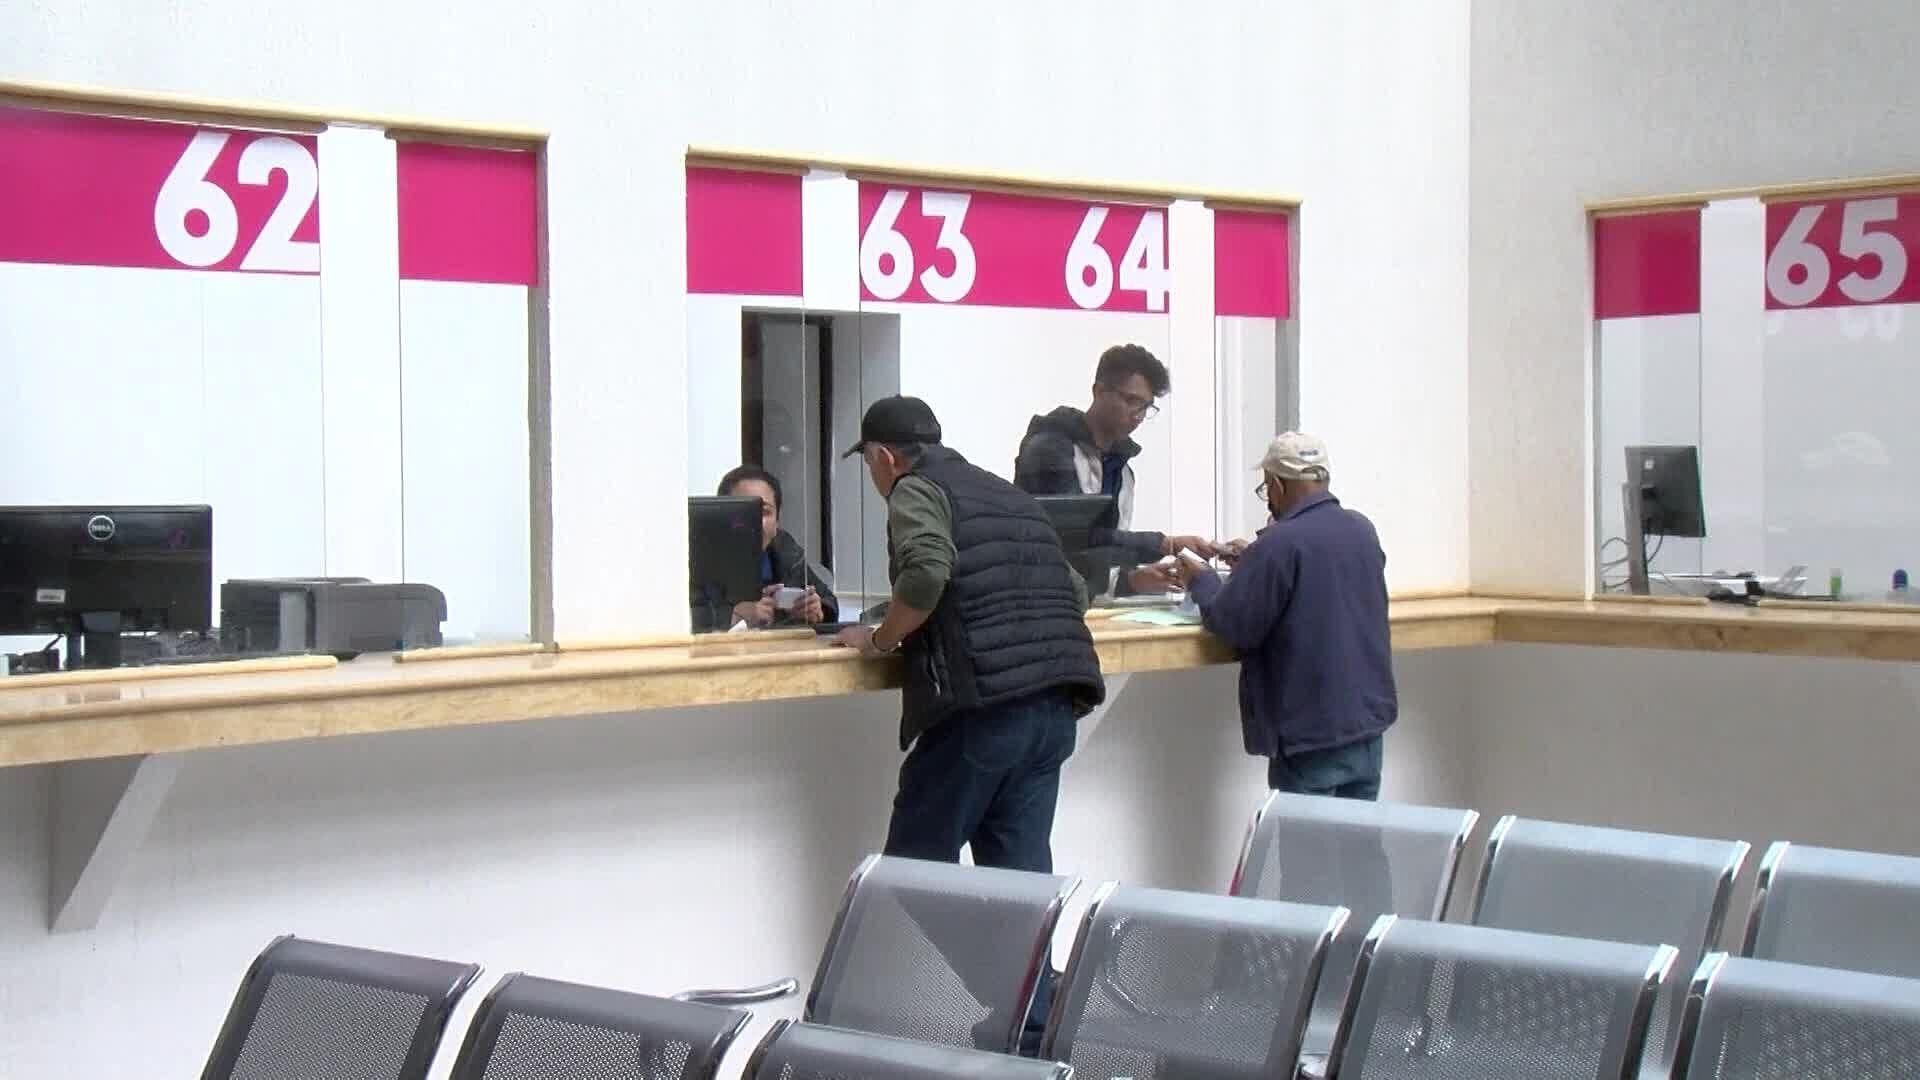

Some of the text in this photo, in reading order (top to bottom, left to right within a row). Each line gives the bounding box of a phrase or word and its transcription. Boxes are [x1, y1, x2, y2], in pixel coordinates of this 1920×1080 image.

[155, 131, 320, 270] 62
[860, 189, 977, 302] 63
[1766, 199, 1907, 306] 65
[1065, 207, 1171, 311] 64
